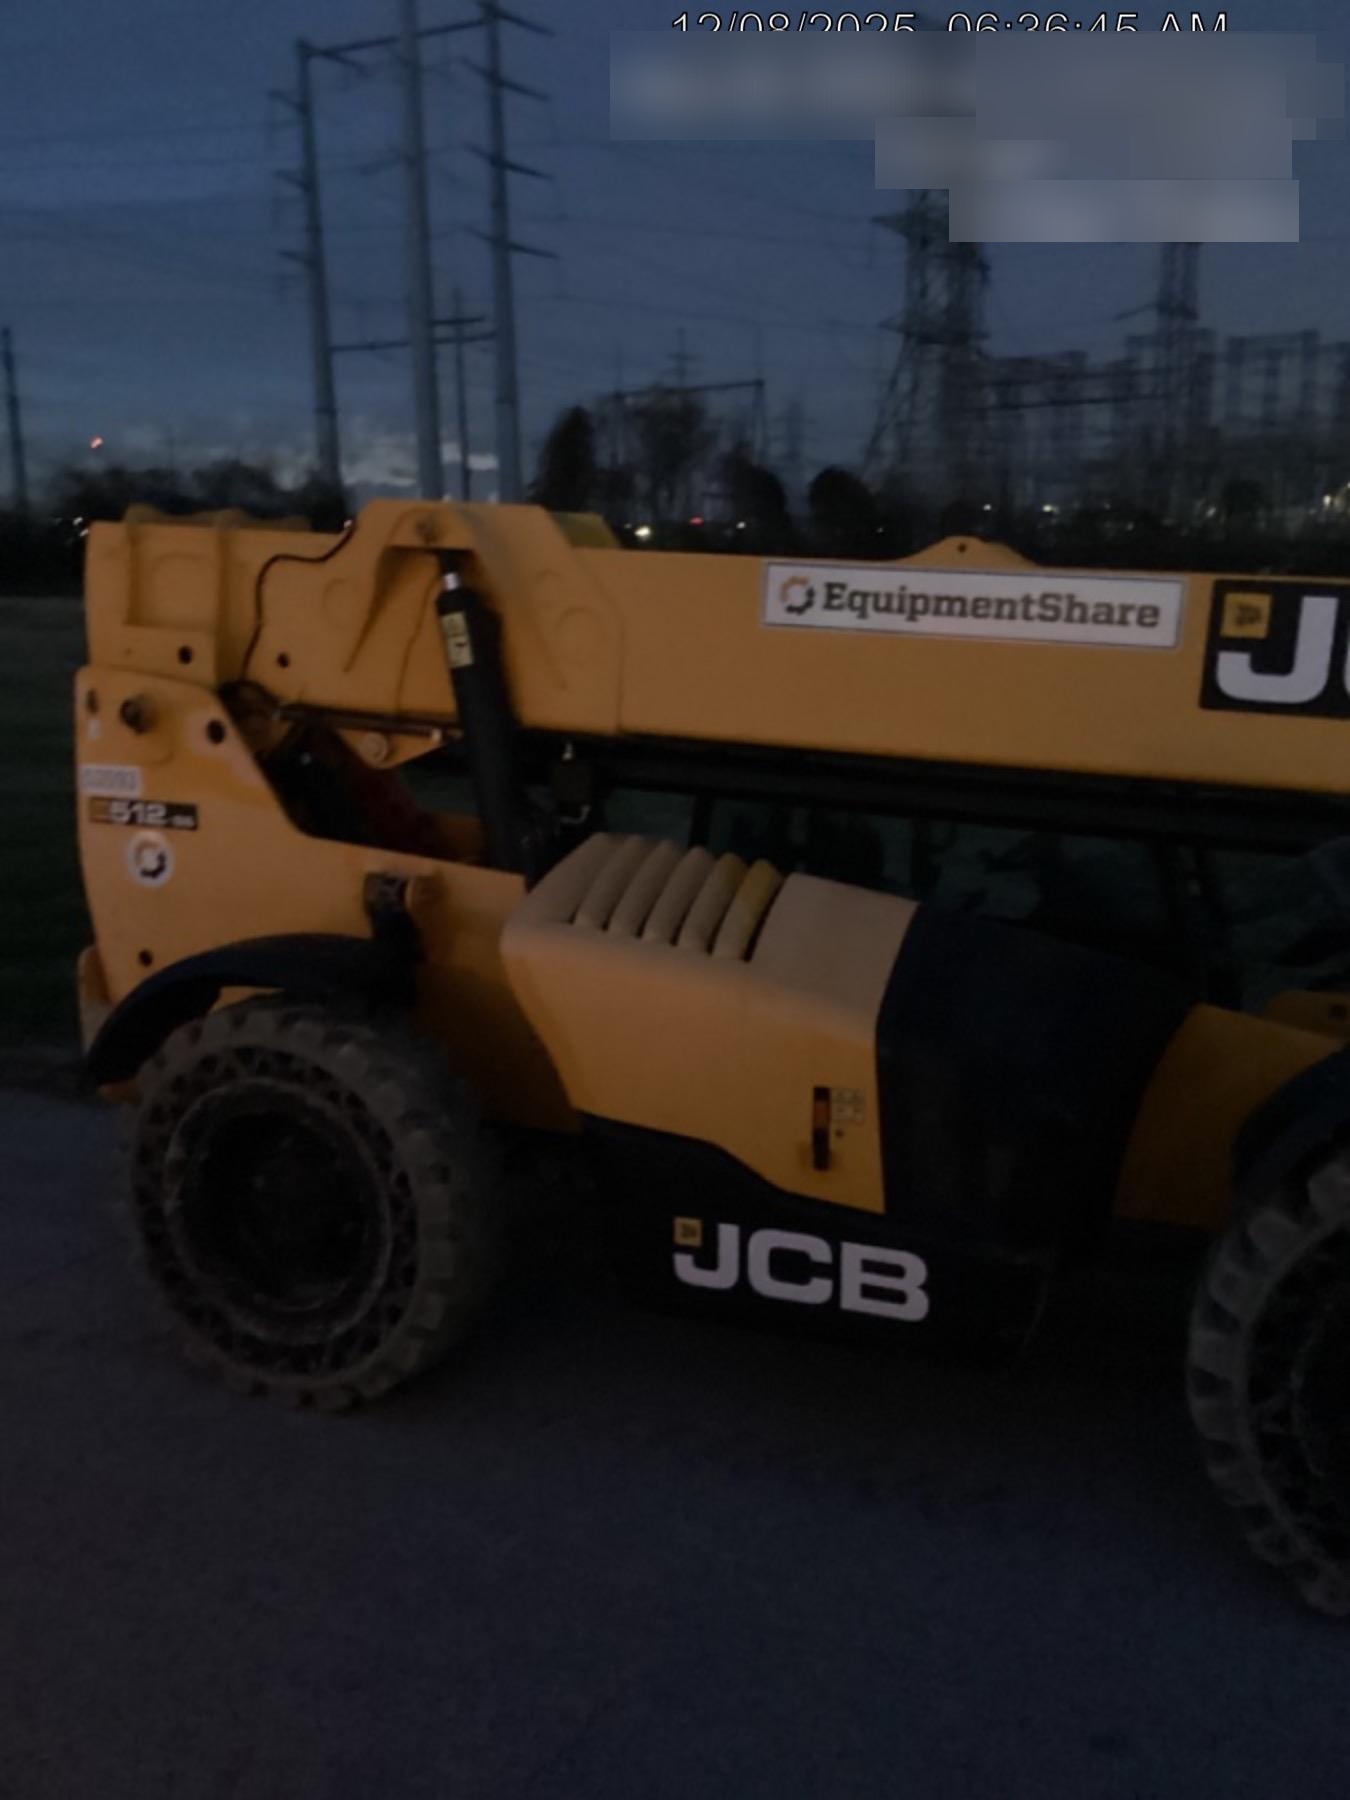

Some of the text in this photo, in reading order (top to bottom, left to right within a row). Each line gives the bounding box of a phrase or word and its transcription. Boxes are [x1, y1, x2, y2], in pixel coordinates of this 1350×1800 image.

[822, 582, 1161, 628] EquipmentShare
[1215, 594, 1350, 705] J
[672, 1221, 931, 1323] JCB
